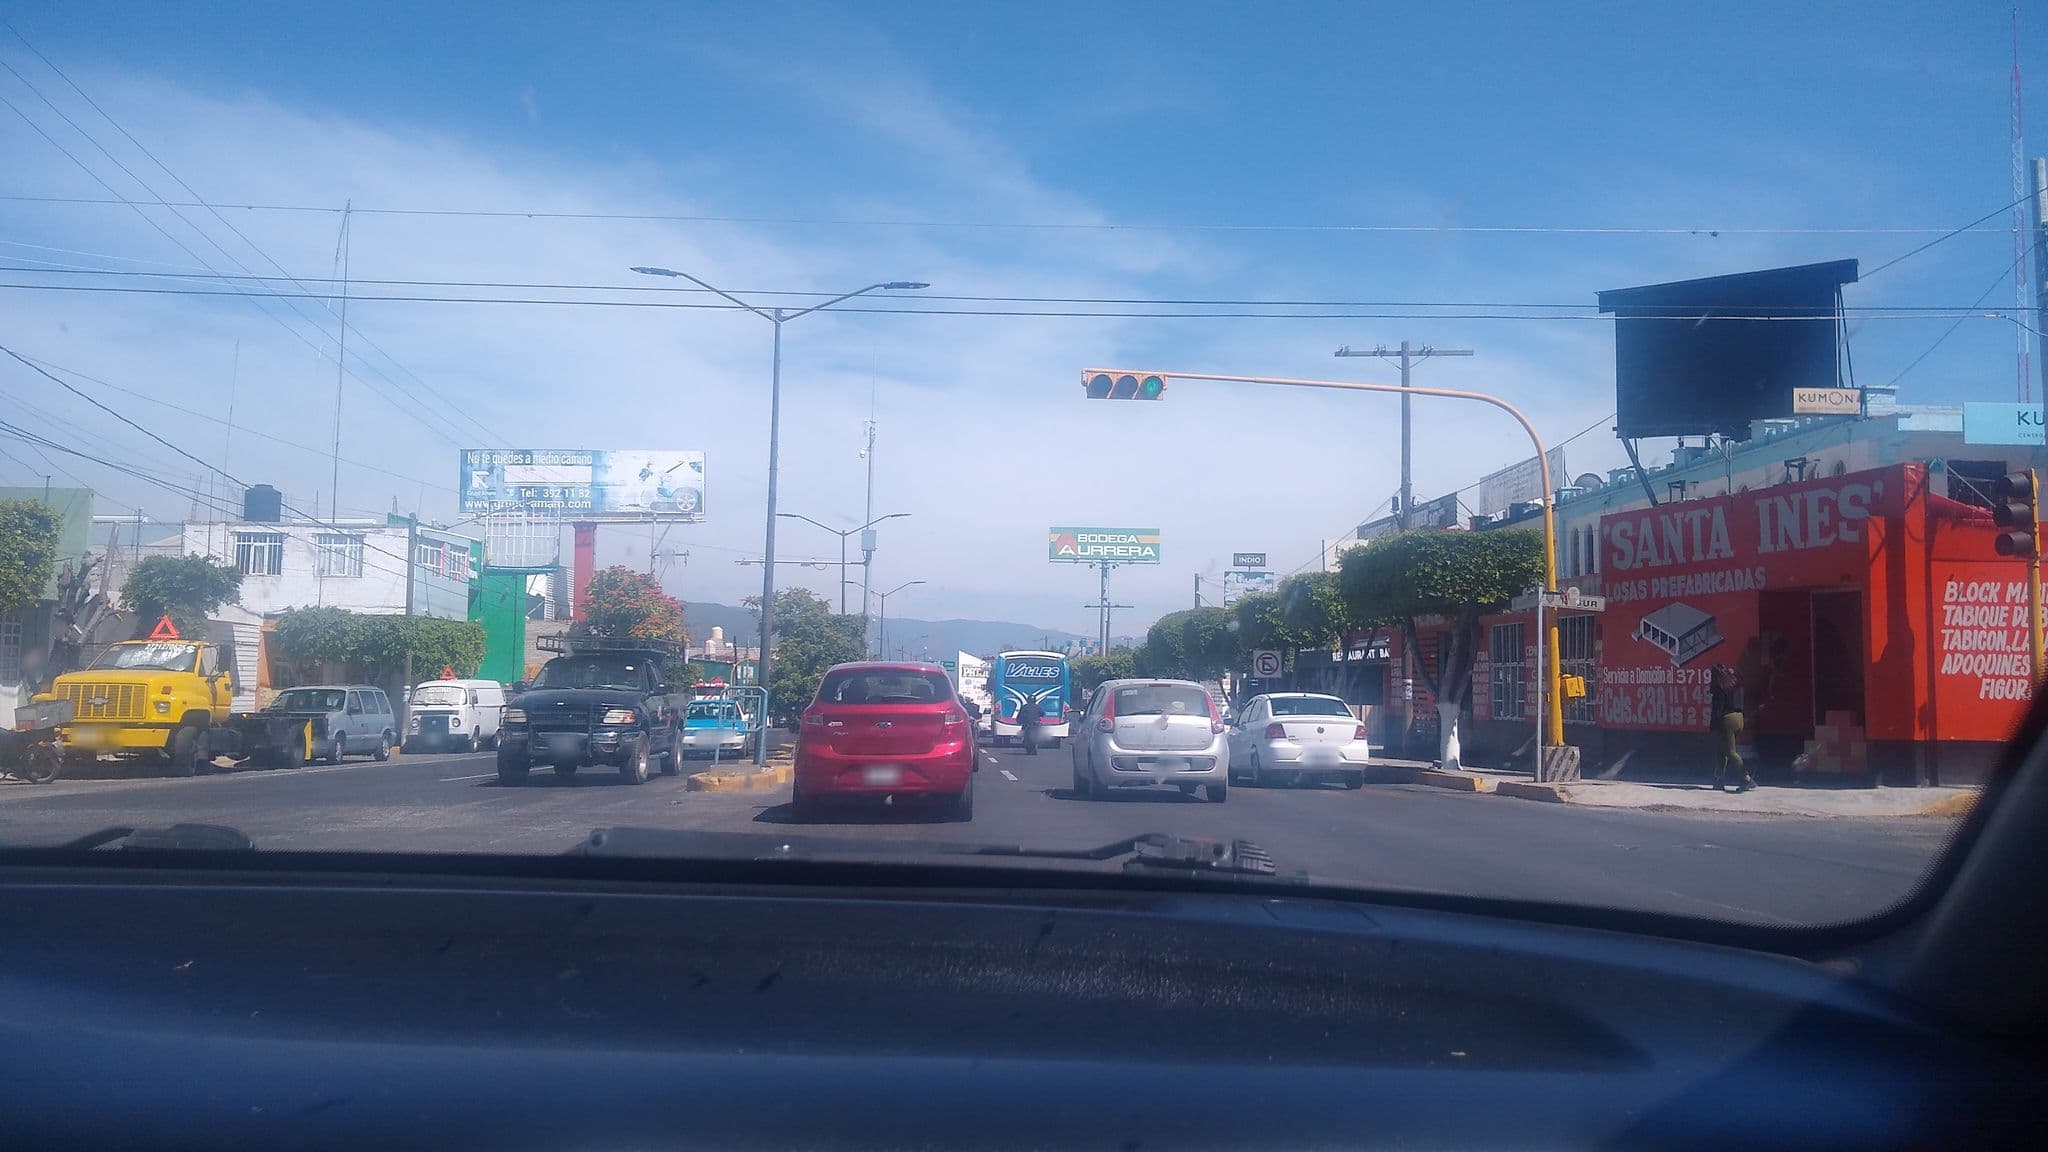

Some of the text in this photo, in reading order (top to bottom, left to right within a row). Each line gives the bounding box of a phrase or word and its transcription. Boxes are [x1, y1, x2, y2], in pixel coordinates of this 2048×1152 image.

[1798, 391, 1854, 406] KUMON
[467, 452, 593, 467] No te quedes a medio camino
[520, 488, 538, 498] Tel:
[543, 488, 561, 498] 392
[1077, 533, 1138, 543] BODEGA
[1058, 544, 1156, 557] AURRERA
[1238, 556, 1261, 564] INDIO
[1606, 579, 1647, 601] LOSAS
[1652, 566, 1766, 598] PREFABRICADAS
[1944, 581, 2001, 603] BLOCK
[1942, 604, 2009, 630] TABIQUE
[1005, 662, 1061, 678] VALLES
[1941, 653, 2031, 678] ADOQUINES
[1603, 666, 1629, 684] Servicio
